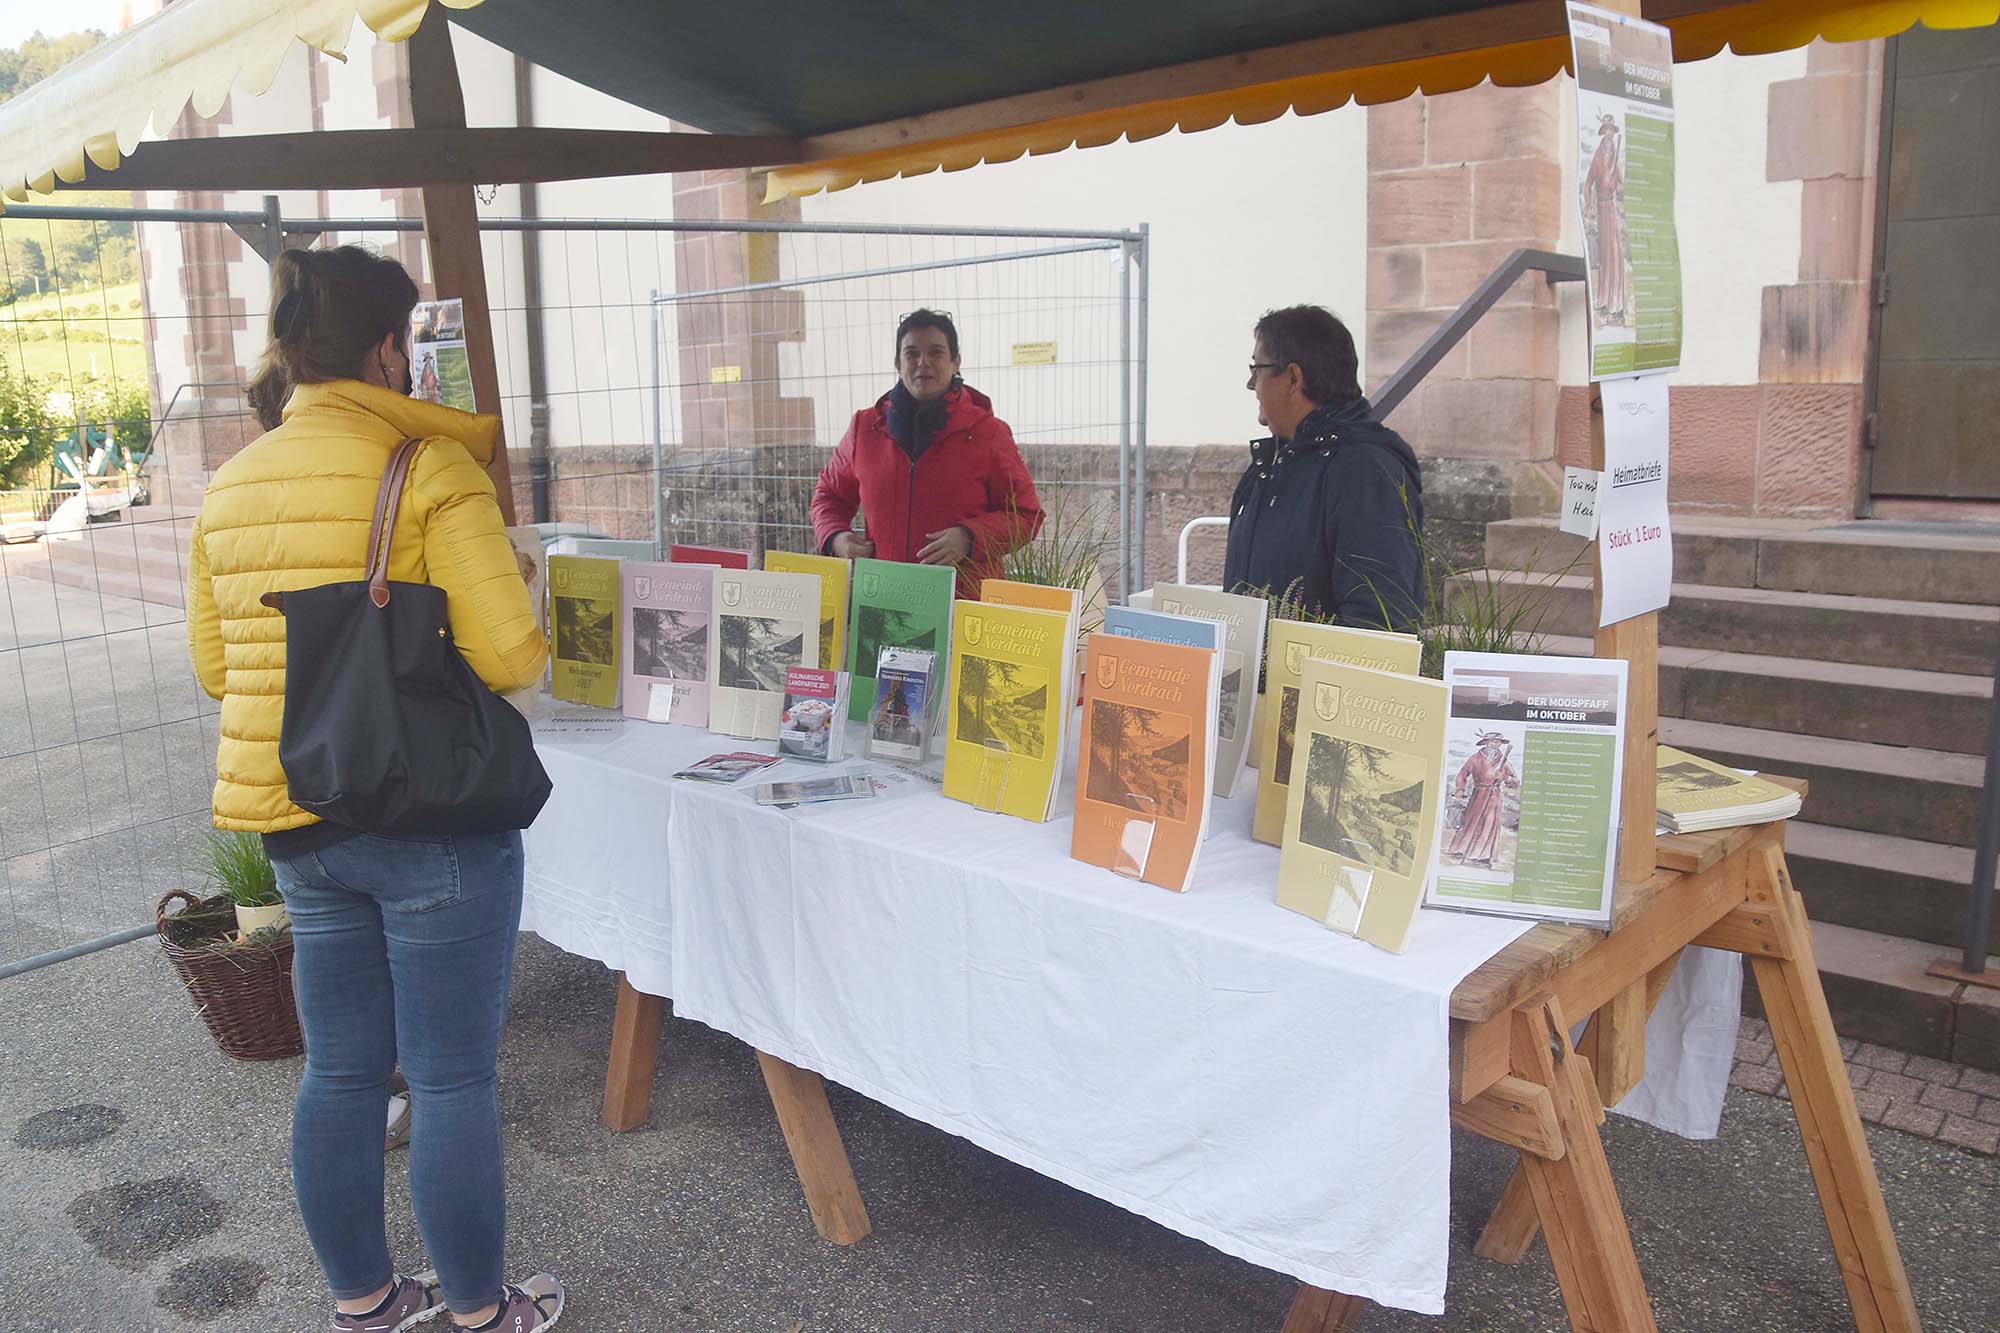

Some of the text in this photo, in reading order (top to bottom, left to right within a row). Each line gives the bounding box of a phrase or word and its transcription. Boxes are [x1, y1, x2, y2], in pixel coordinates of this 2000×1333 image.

[1623, 61, 1635, 76] DER
[1625, 81, 1660, 100] IM OKTOBER
[1613, 461, 1661, 485] Heimatbriefe
[1609, 525, 1661, 550] Stück 1 Euro
[651, 577, 704, 592] Gemeinde
[1182, 603, 1244, 628] Gemeinde
[984, 618, 1049, 642] Gemeinde
[981, 633, 1041, 657] Nordrach
[1120, 657, 1191, 685] Gemeinde
[1118, 676, 1184, 703] Nordrach
[1342, 687, 1426, 723] Gemeinde
[1526, 709, 1587, 721] IM OKTOBER
[1527, 696, 1547, 707] DER
[1549, 697, 1609, 710] MOOSPFAFF
[1341, 708, 1418, 743] Nordrach
